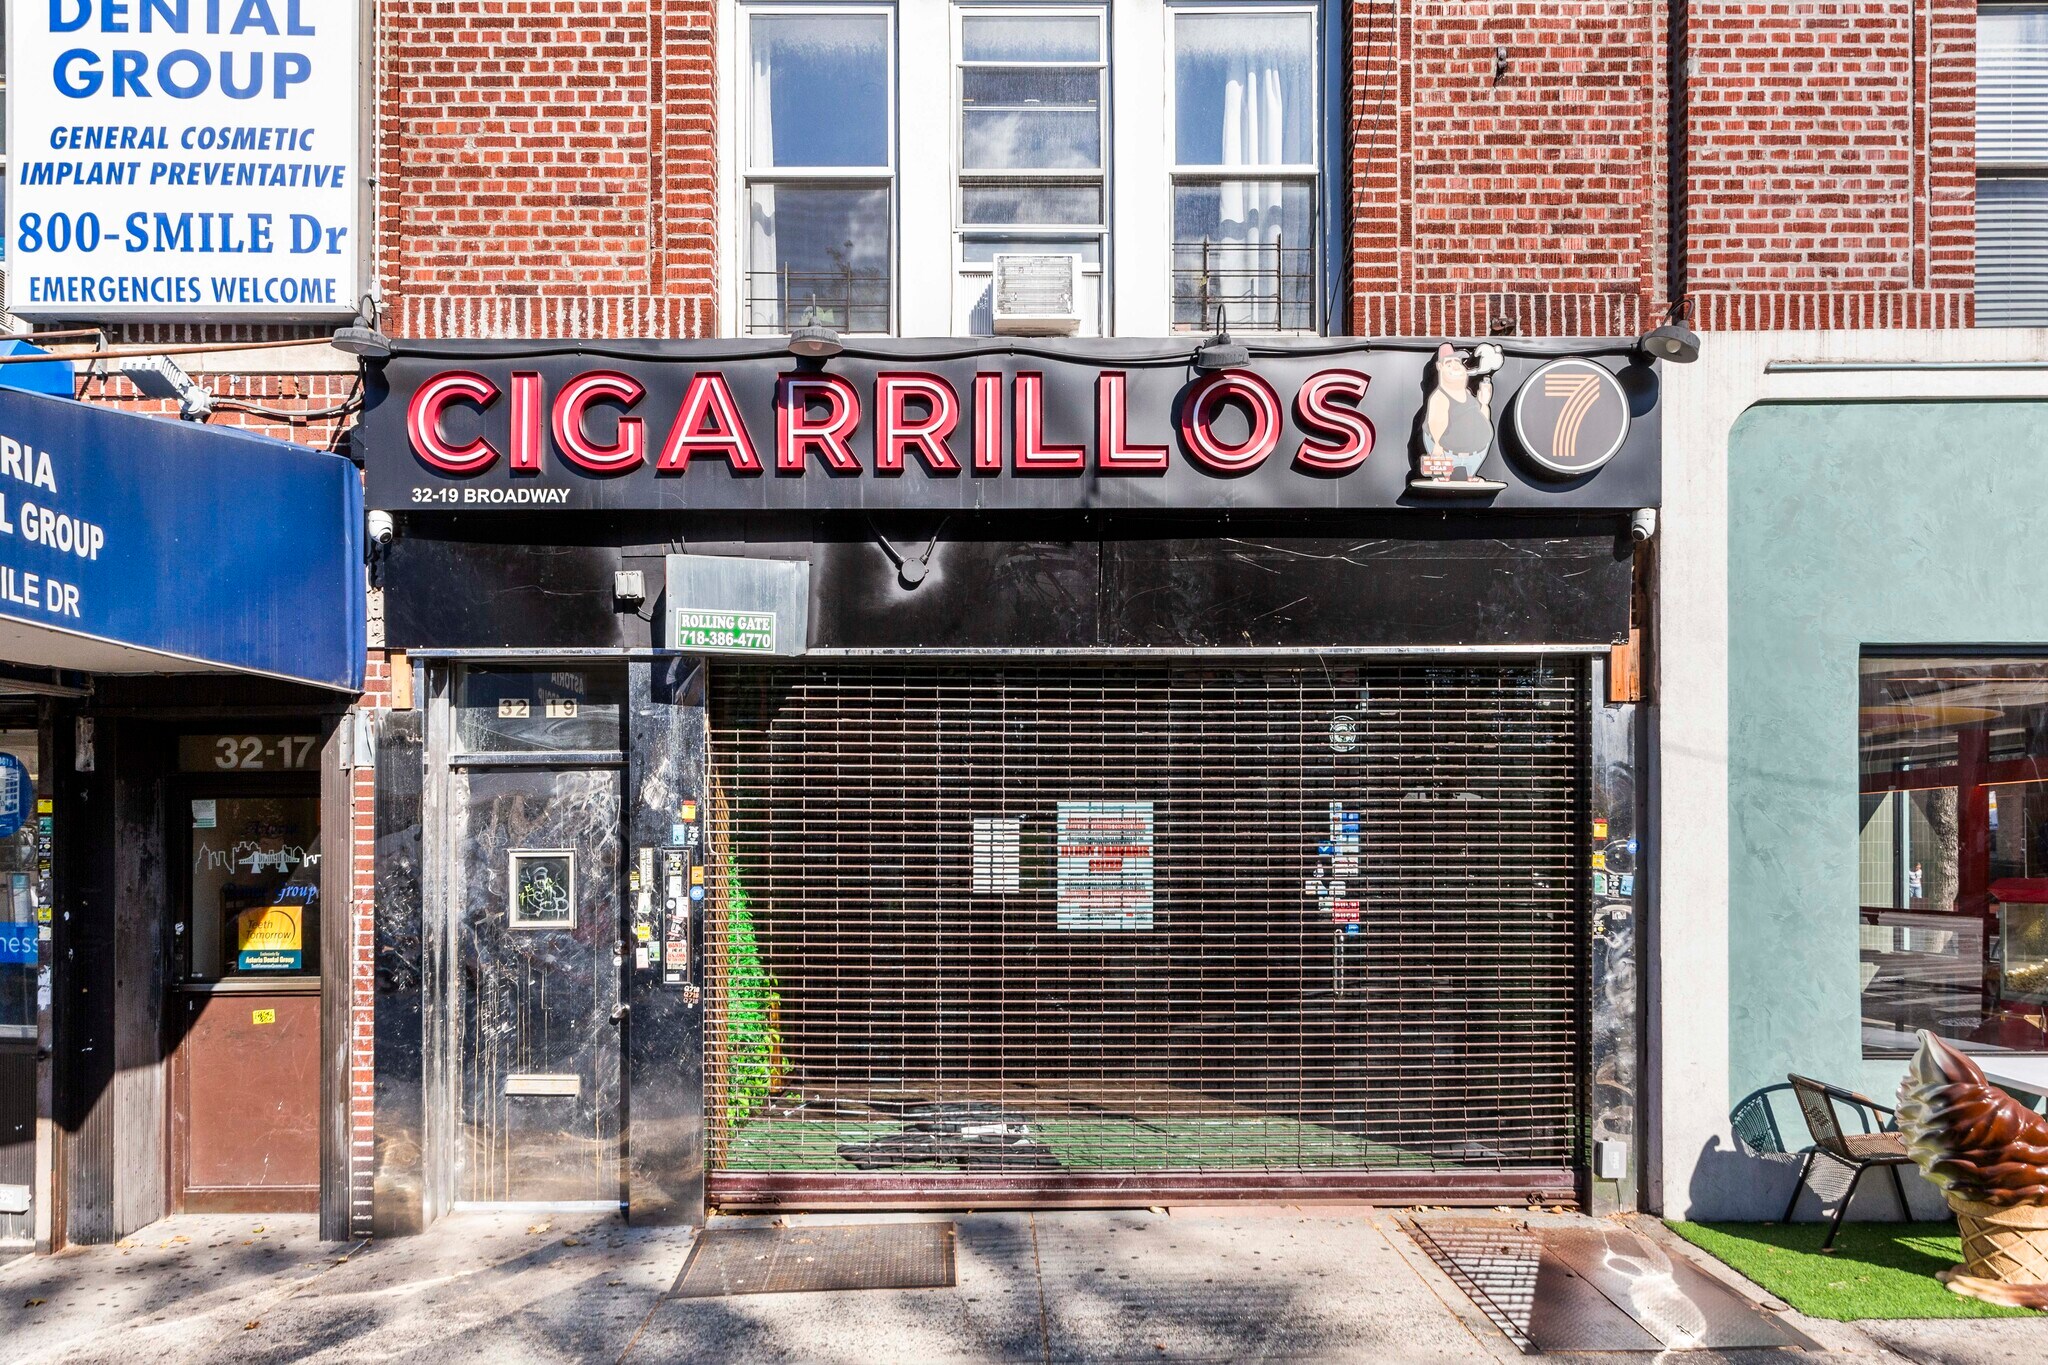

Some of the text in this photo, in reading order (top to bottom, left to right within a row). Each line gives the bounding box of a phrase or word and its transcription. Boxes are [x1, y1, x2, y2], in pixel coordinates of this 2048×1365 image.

[49, 0, 316, 36] DENTAL
[53, 48, 312, 100] GROUP
[50, 126, 315, 152] GENERAL COSMETIC
[20, 162, 346, 188] IMPLANT PREVENTATIVE
[17, 211, 348, 254] 800-SMILE Dr
[30, 276, 336, 304] EMERGENCIES WELCOME
[406, 368, 1377, 475] CIGARRILLOS
[1544, 373, 1601, 457] 7
[411, 488, 571, 503] 32-19 BROADWAY
[20, 502, 104, 560] GROUP
[46, 579, 81, 618] DR
[681, 614, 770, 631] ROLLING GATE
[680, 630, 771, 648] 718-386-4770
[501, 700, 576, 716] 32 19
[215, 736, 316, 769] 32-17
[245, 930, 292, 940] Tomorrow
[247, 919, 273, 929] Teeth
